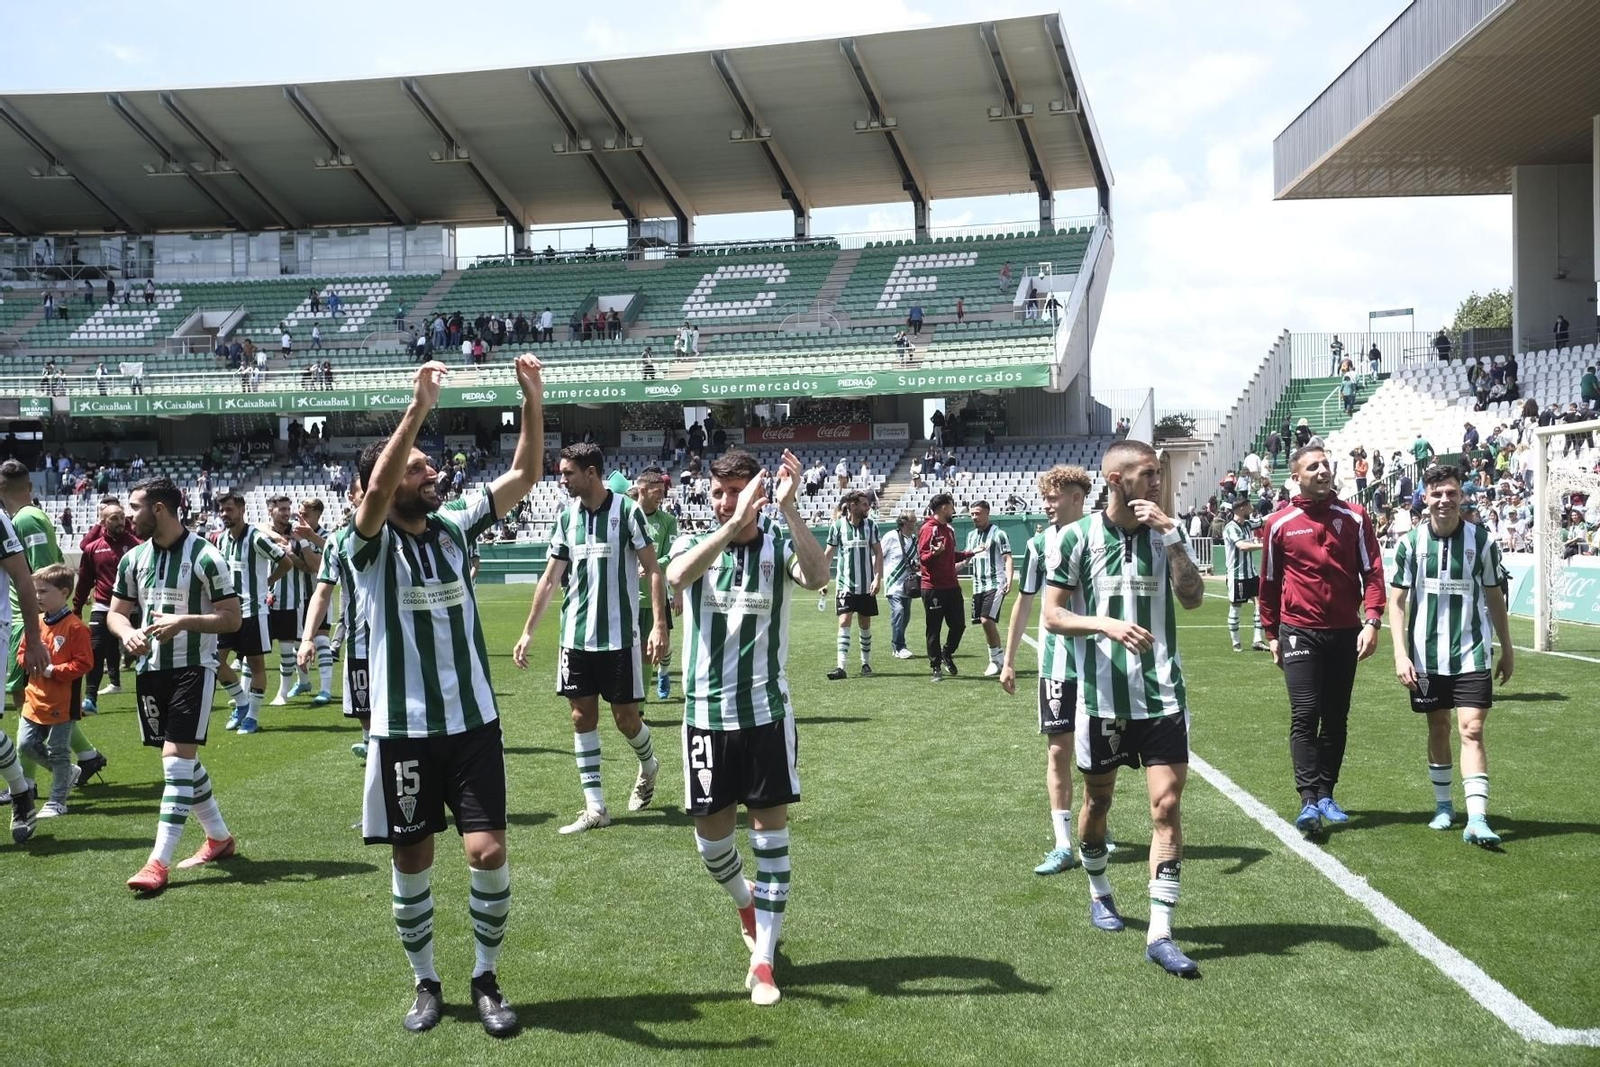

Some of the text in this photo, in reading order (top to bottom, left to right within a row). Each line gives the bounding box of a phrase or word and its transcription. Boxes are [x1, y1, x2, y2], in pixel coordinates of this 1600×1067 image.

[837, 371, 1022, 387] PIEDRA Supermercados
[516, 387, 626, 400] Sermercados
[645, 380, 818, 395] PIEDRA Supermercados
[164, 400, 204, 410] CaixaBank
[237, 398, 277, 408] CaixaBank
[309, 397, 350, 407] CaixaBank
[382, 395, 416, 404] CaixaBa
[91, 402, 132, 411] CaixaBank
[1286, 528, 1313, 537] GIVOVA
[1284, 650, 1310, 658] GIVOVA
[351, 669, 368, 690] 10
[1045, 678, 1063, 700] 18
[142, 695, 160, 717] 16
[692, 735, 713, 768] 21
[395, 760, 420, 796] 15
[394, 821, 426, 833] GIVOVA
